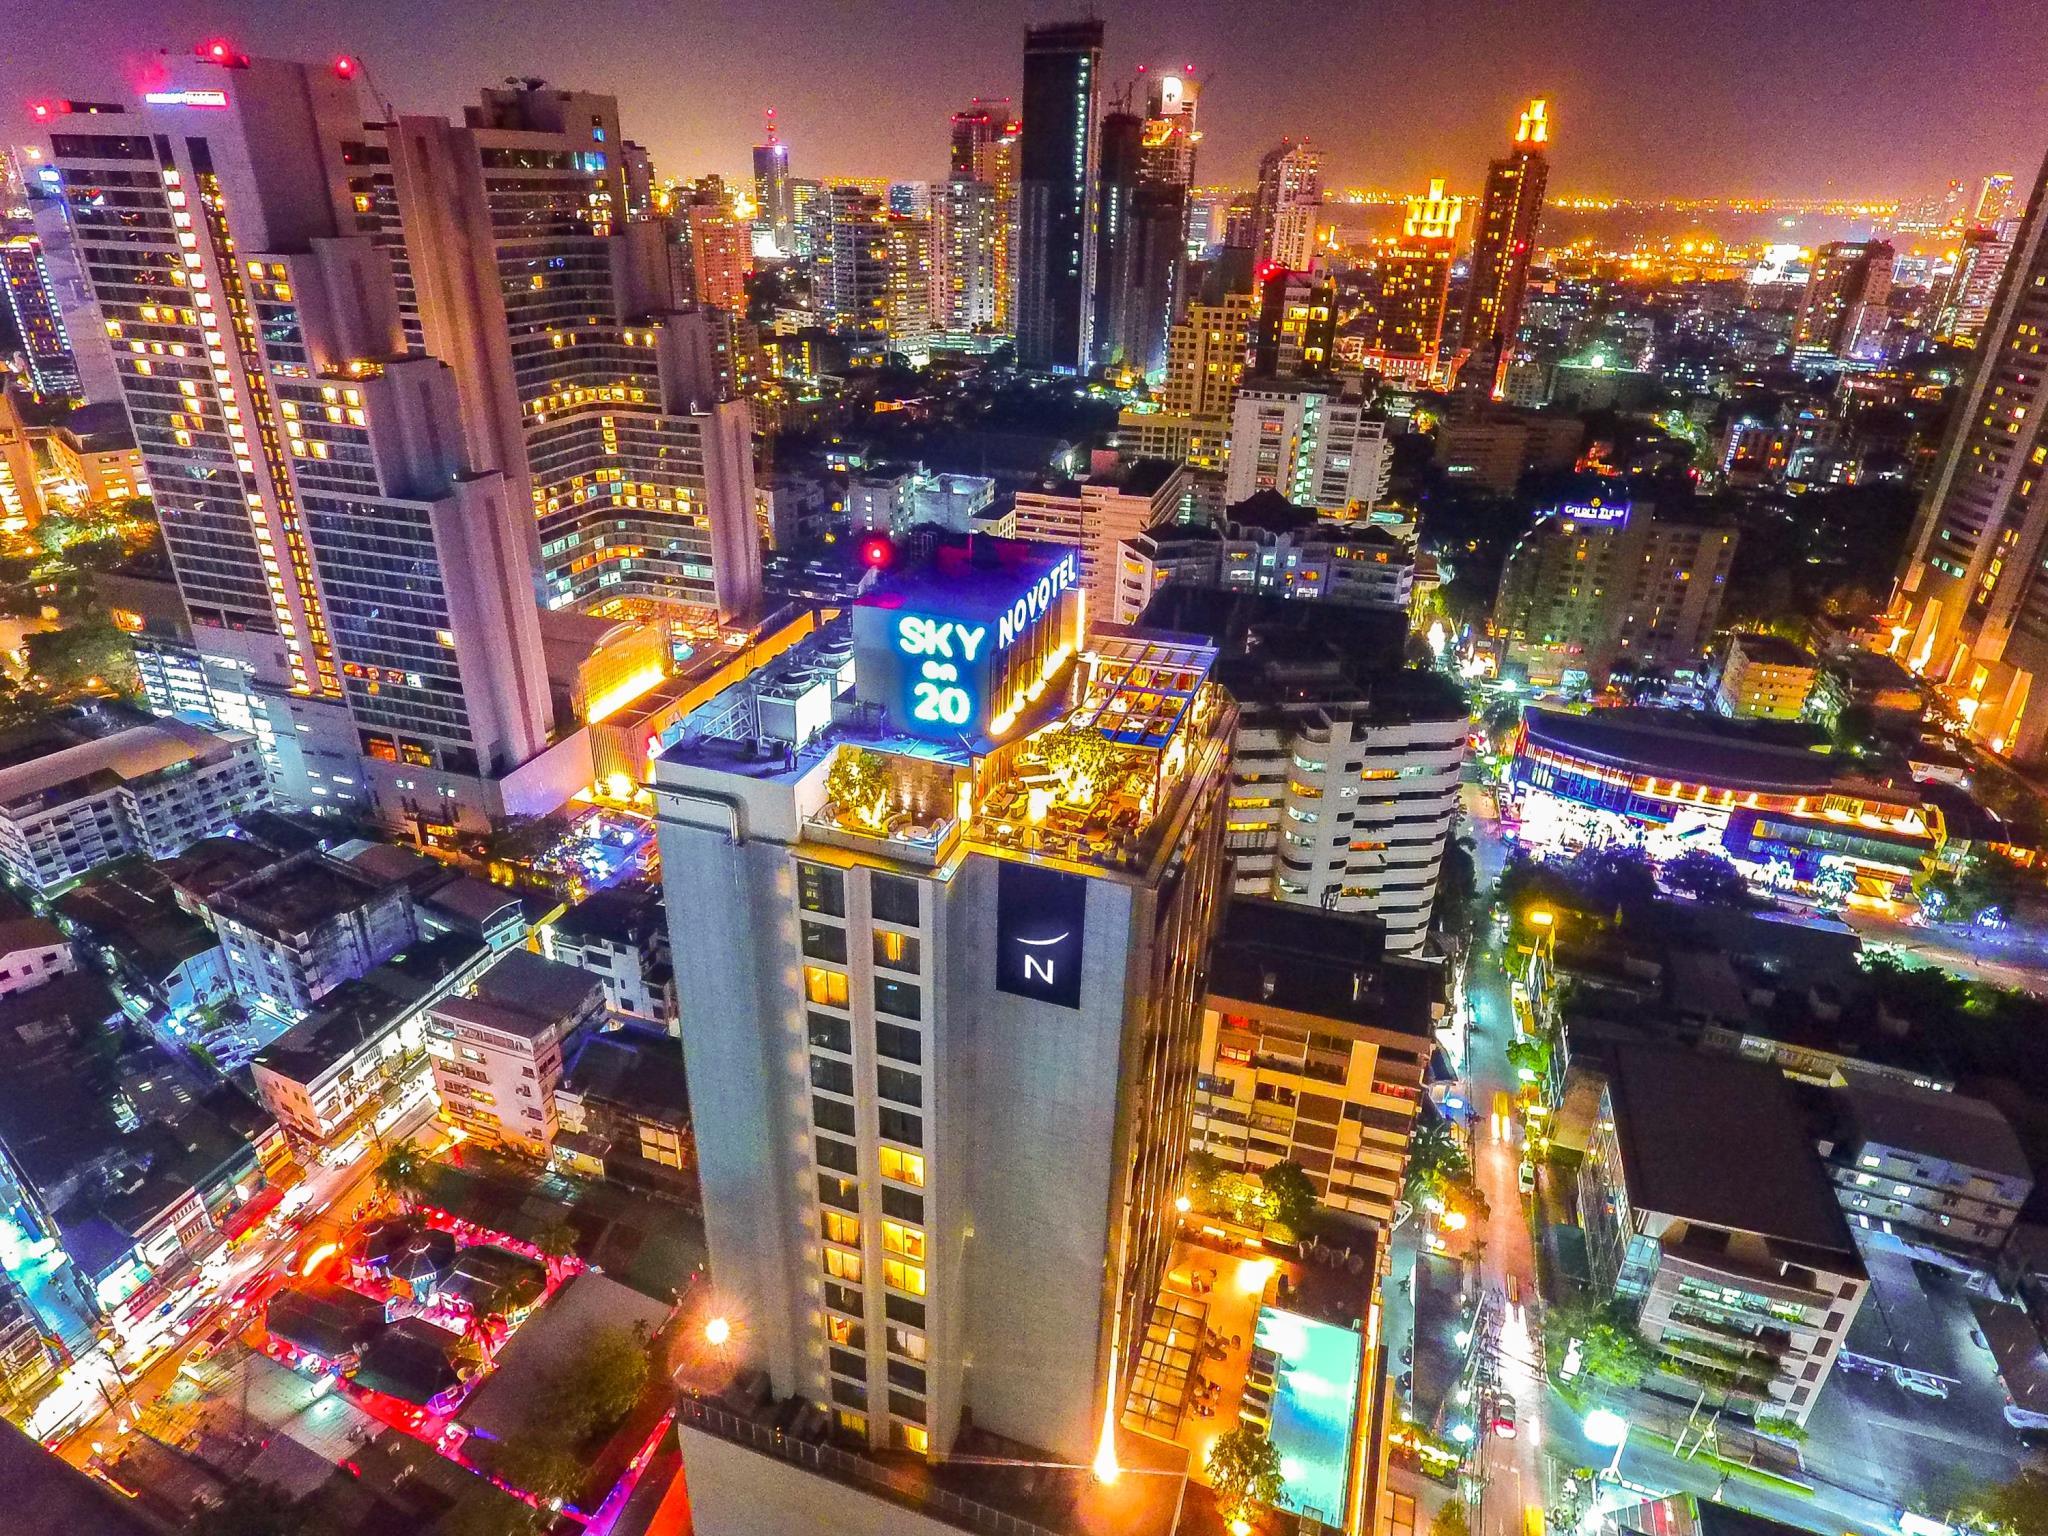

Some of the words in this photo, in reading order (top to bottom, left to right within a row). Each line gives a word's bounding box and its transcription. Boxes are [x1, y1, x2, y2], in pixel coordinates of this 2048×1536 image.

[998, 554, 1077, 650] NOVOTEL
[899, 616, 986, 662] SKY
[922, 660, 959, 682] on
[913, 682, 971, 725] 20
[1024, 953, 1054, 985] N
